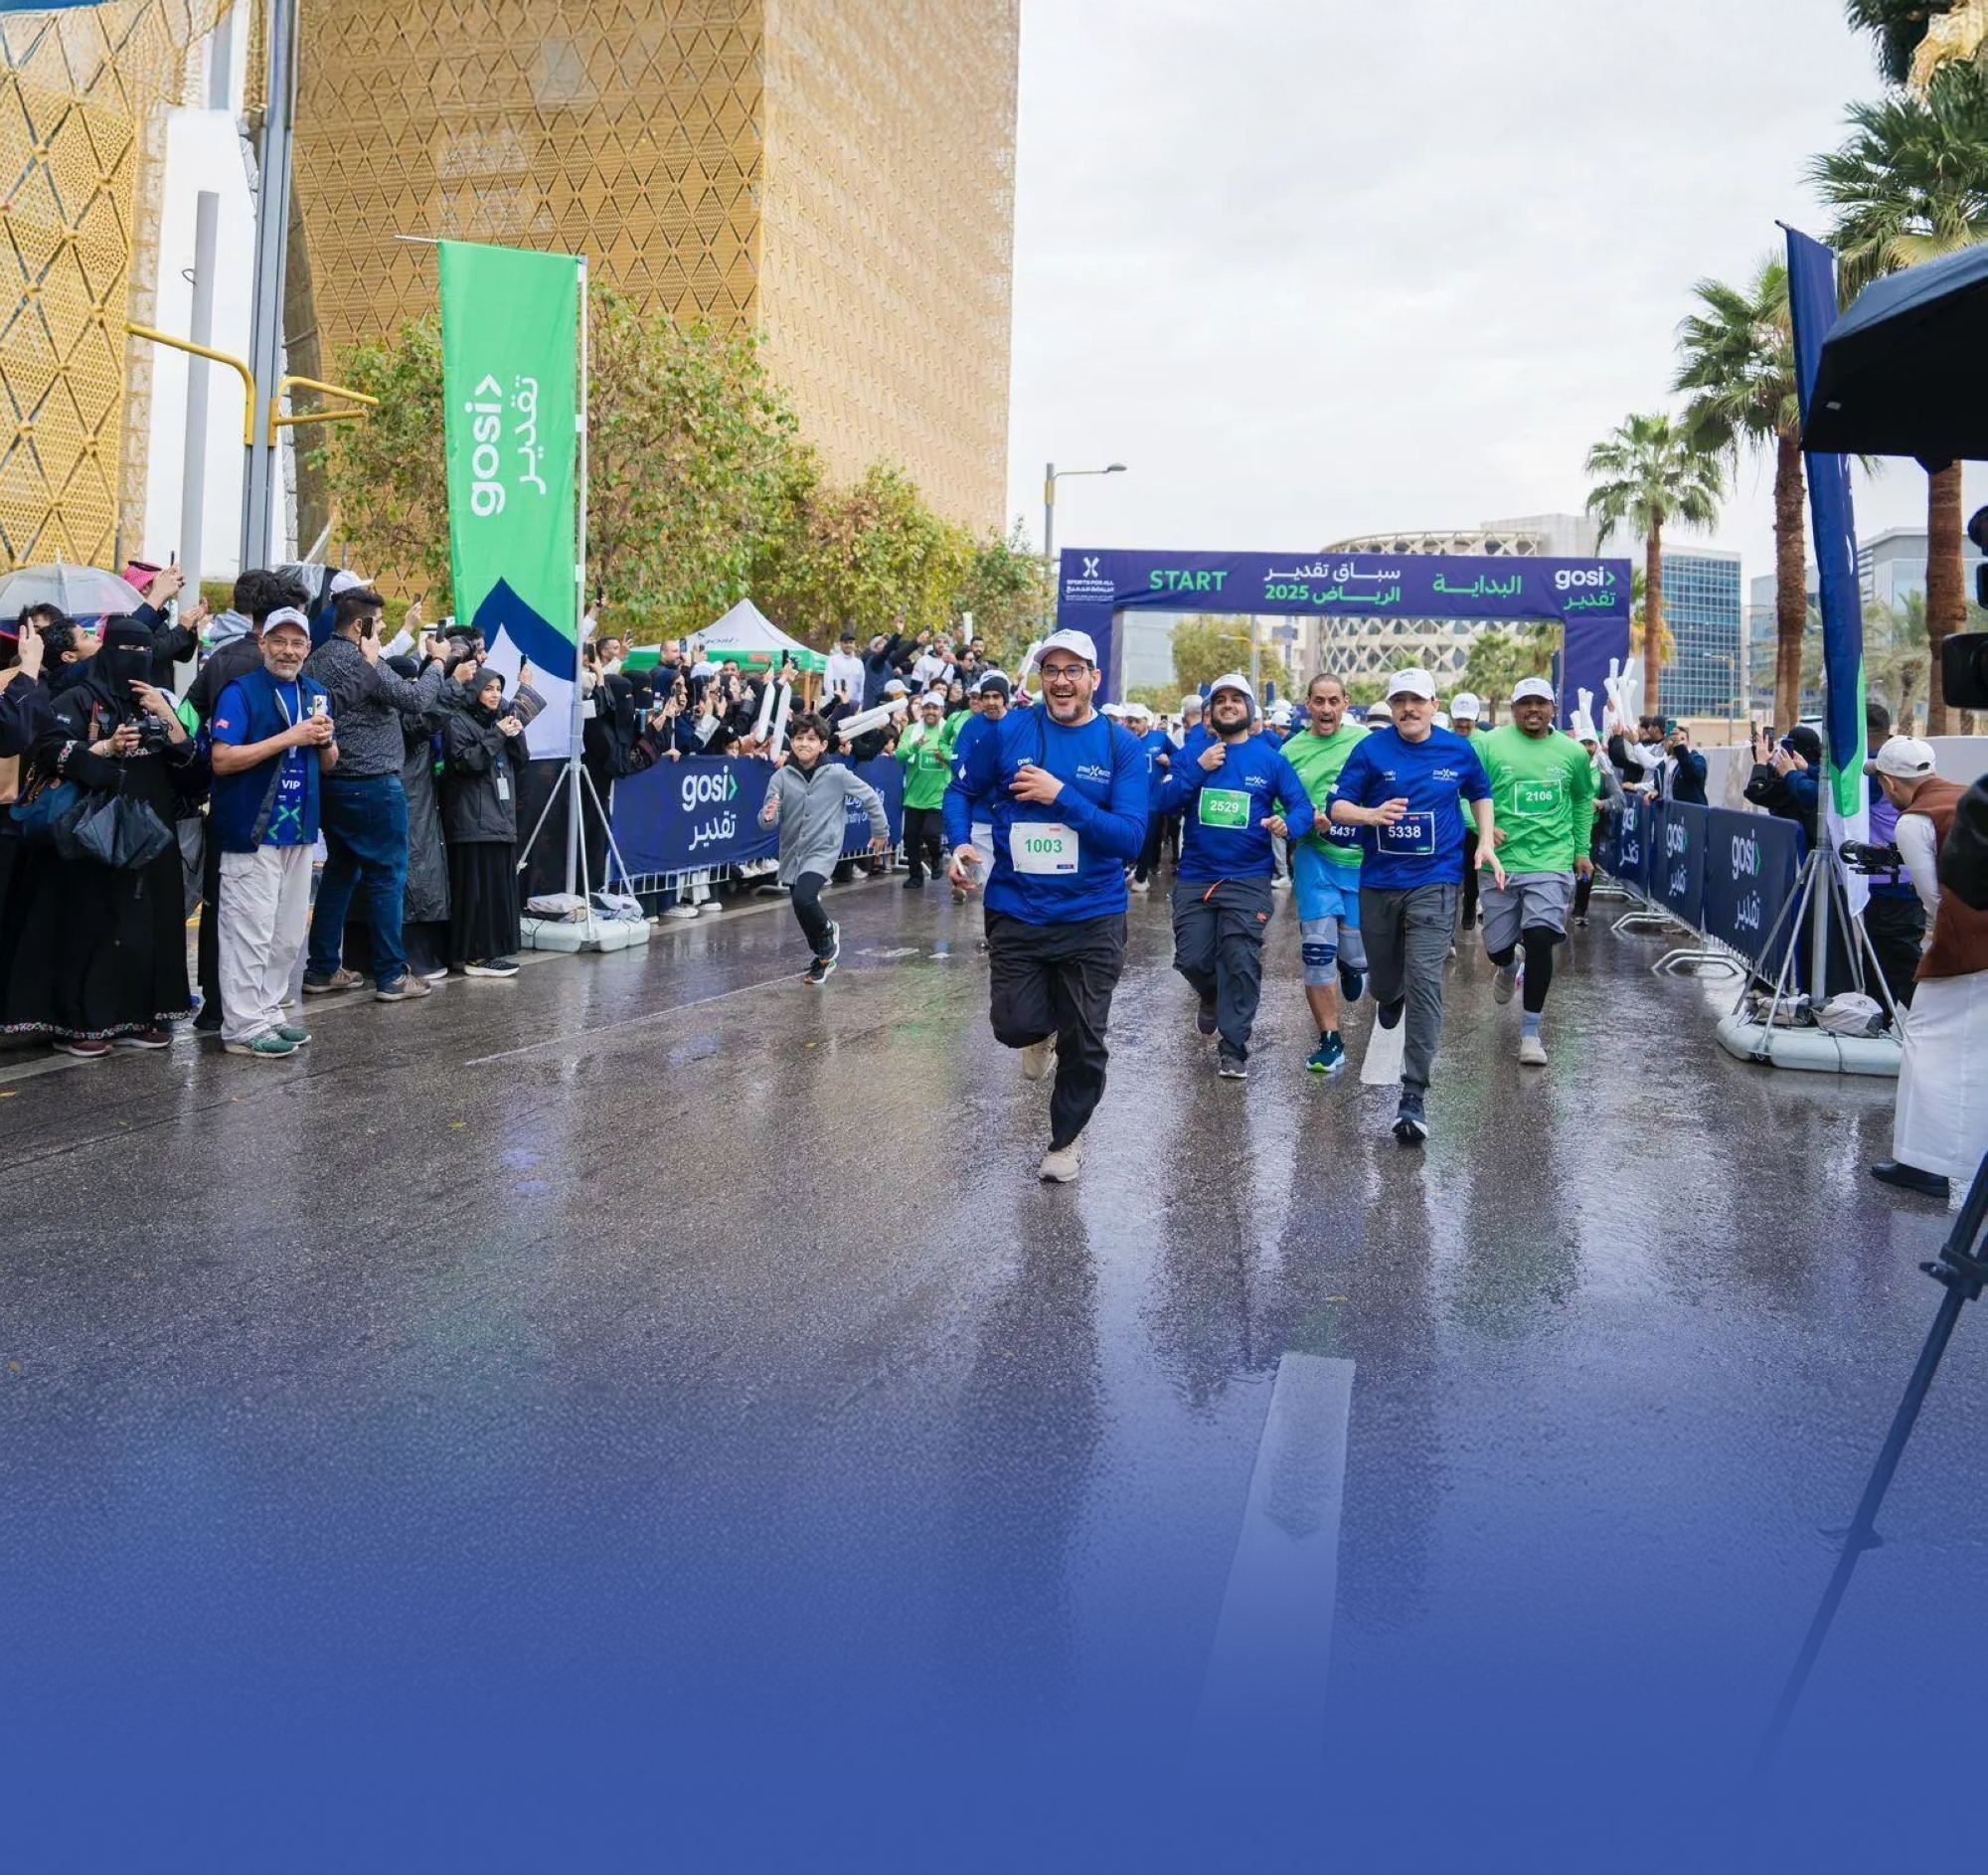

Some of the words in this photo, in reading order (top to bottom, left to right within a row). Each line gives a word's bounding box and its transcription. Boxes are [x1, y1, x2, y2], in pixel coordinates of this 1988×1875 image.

[510, 374, 547, 495] تقدير
[464, 401, 506, 517] gosi
[1149, 570, 1228, 592] START
[1263, 561, 1330, 582] تقدير
[1332, 561, 1402, 583] سباق
[1554, 566, 1604, 591] gosi
[1264, 584, 1310, 600] 2025
[1312, 585, 1401, 605] الرياض
[1432, 573, 1523, 598] البداية
[1563, 590, 1617, 611] تقدير
[281, 779, 301, 789] VIP
[682, 765, 729, 812] gosi
[1210, 799, 1240, 813] 2529
[1525, 790, 1553, 801] 2106
[688, 809, 737, 851] تقدير
[1388, 825, 1421, 839] 5338
[1666, 815, 1686, 859] gosi
[1025, 838, 1063, 854] 1003
[1732, 828, 1755, 881] gosi
[1734, 889, 1760, 932] تقدير
